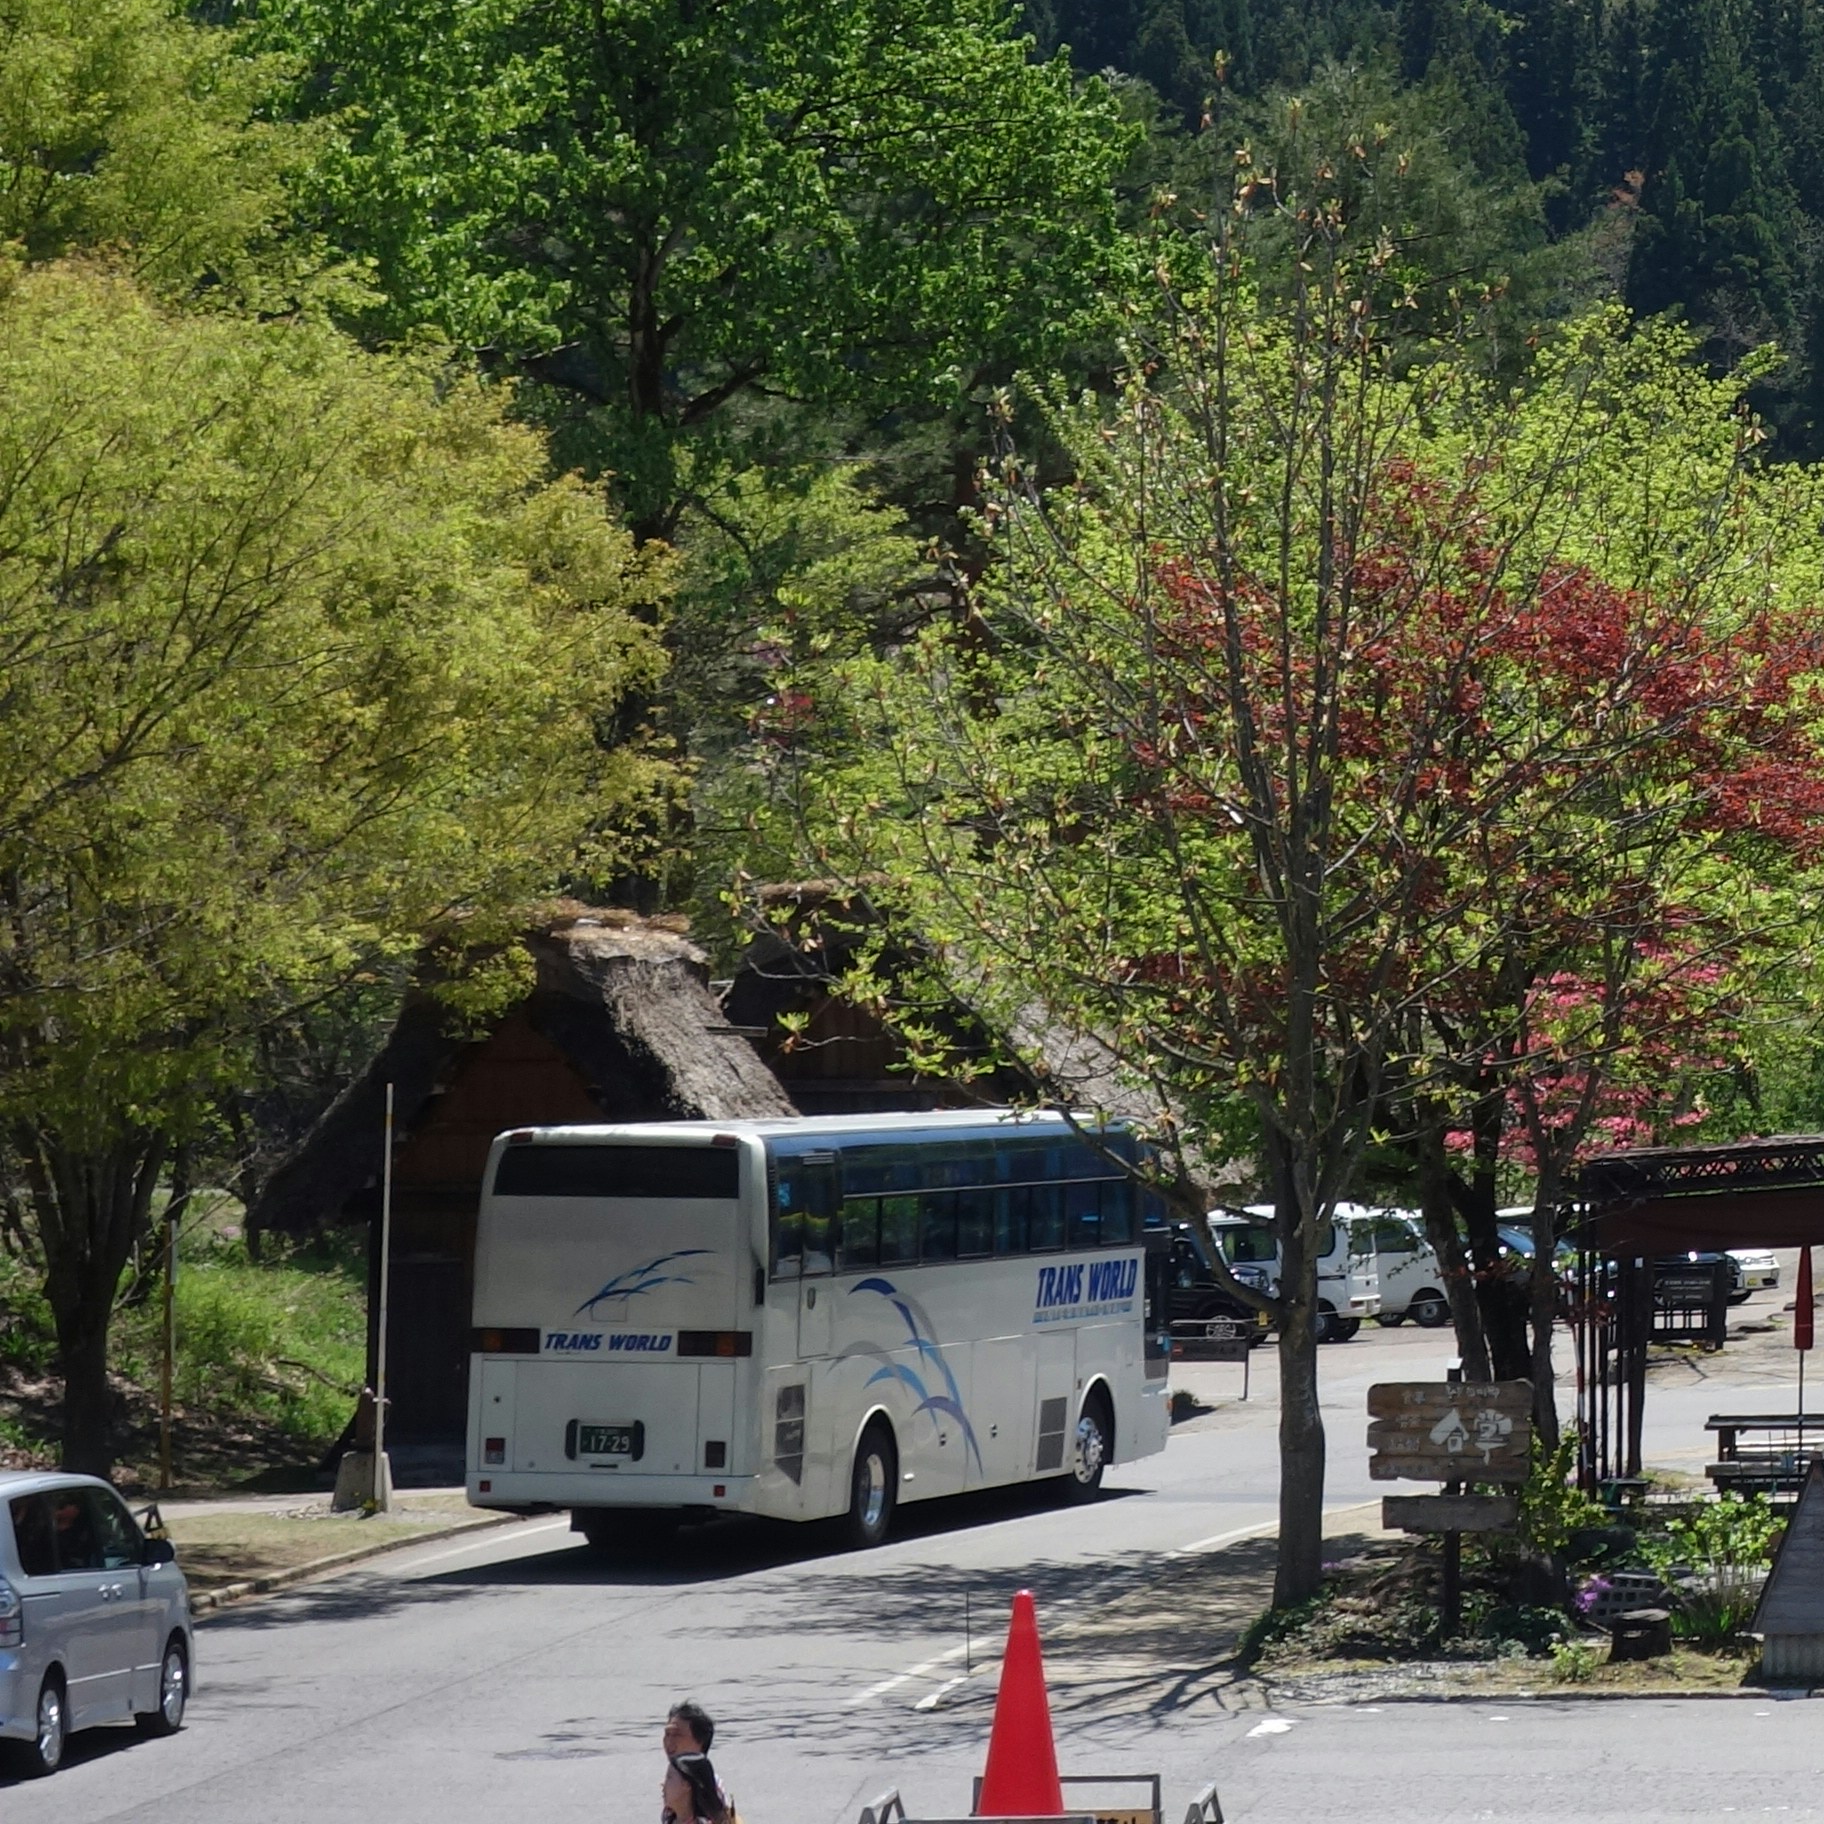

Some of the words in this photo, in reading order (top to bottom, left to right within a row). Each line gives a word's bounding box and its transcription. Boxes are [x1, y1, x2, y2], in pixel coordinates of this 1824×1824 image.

[1036, 1264, 1084, 1308] TRANS
[1087, 1259, 1138, 1302] WORLD
[544, 1333, 604, 1351] TRANS
[608, 1335, 673, 1352] WORLD
